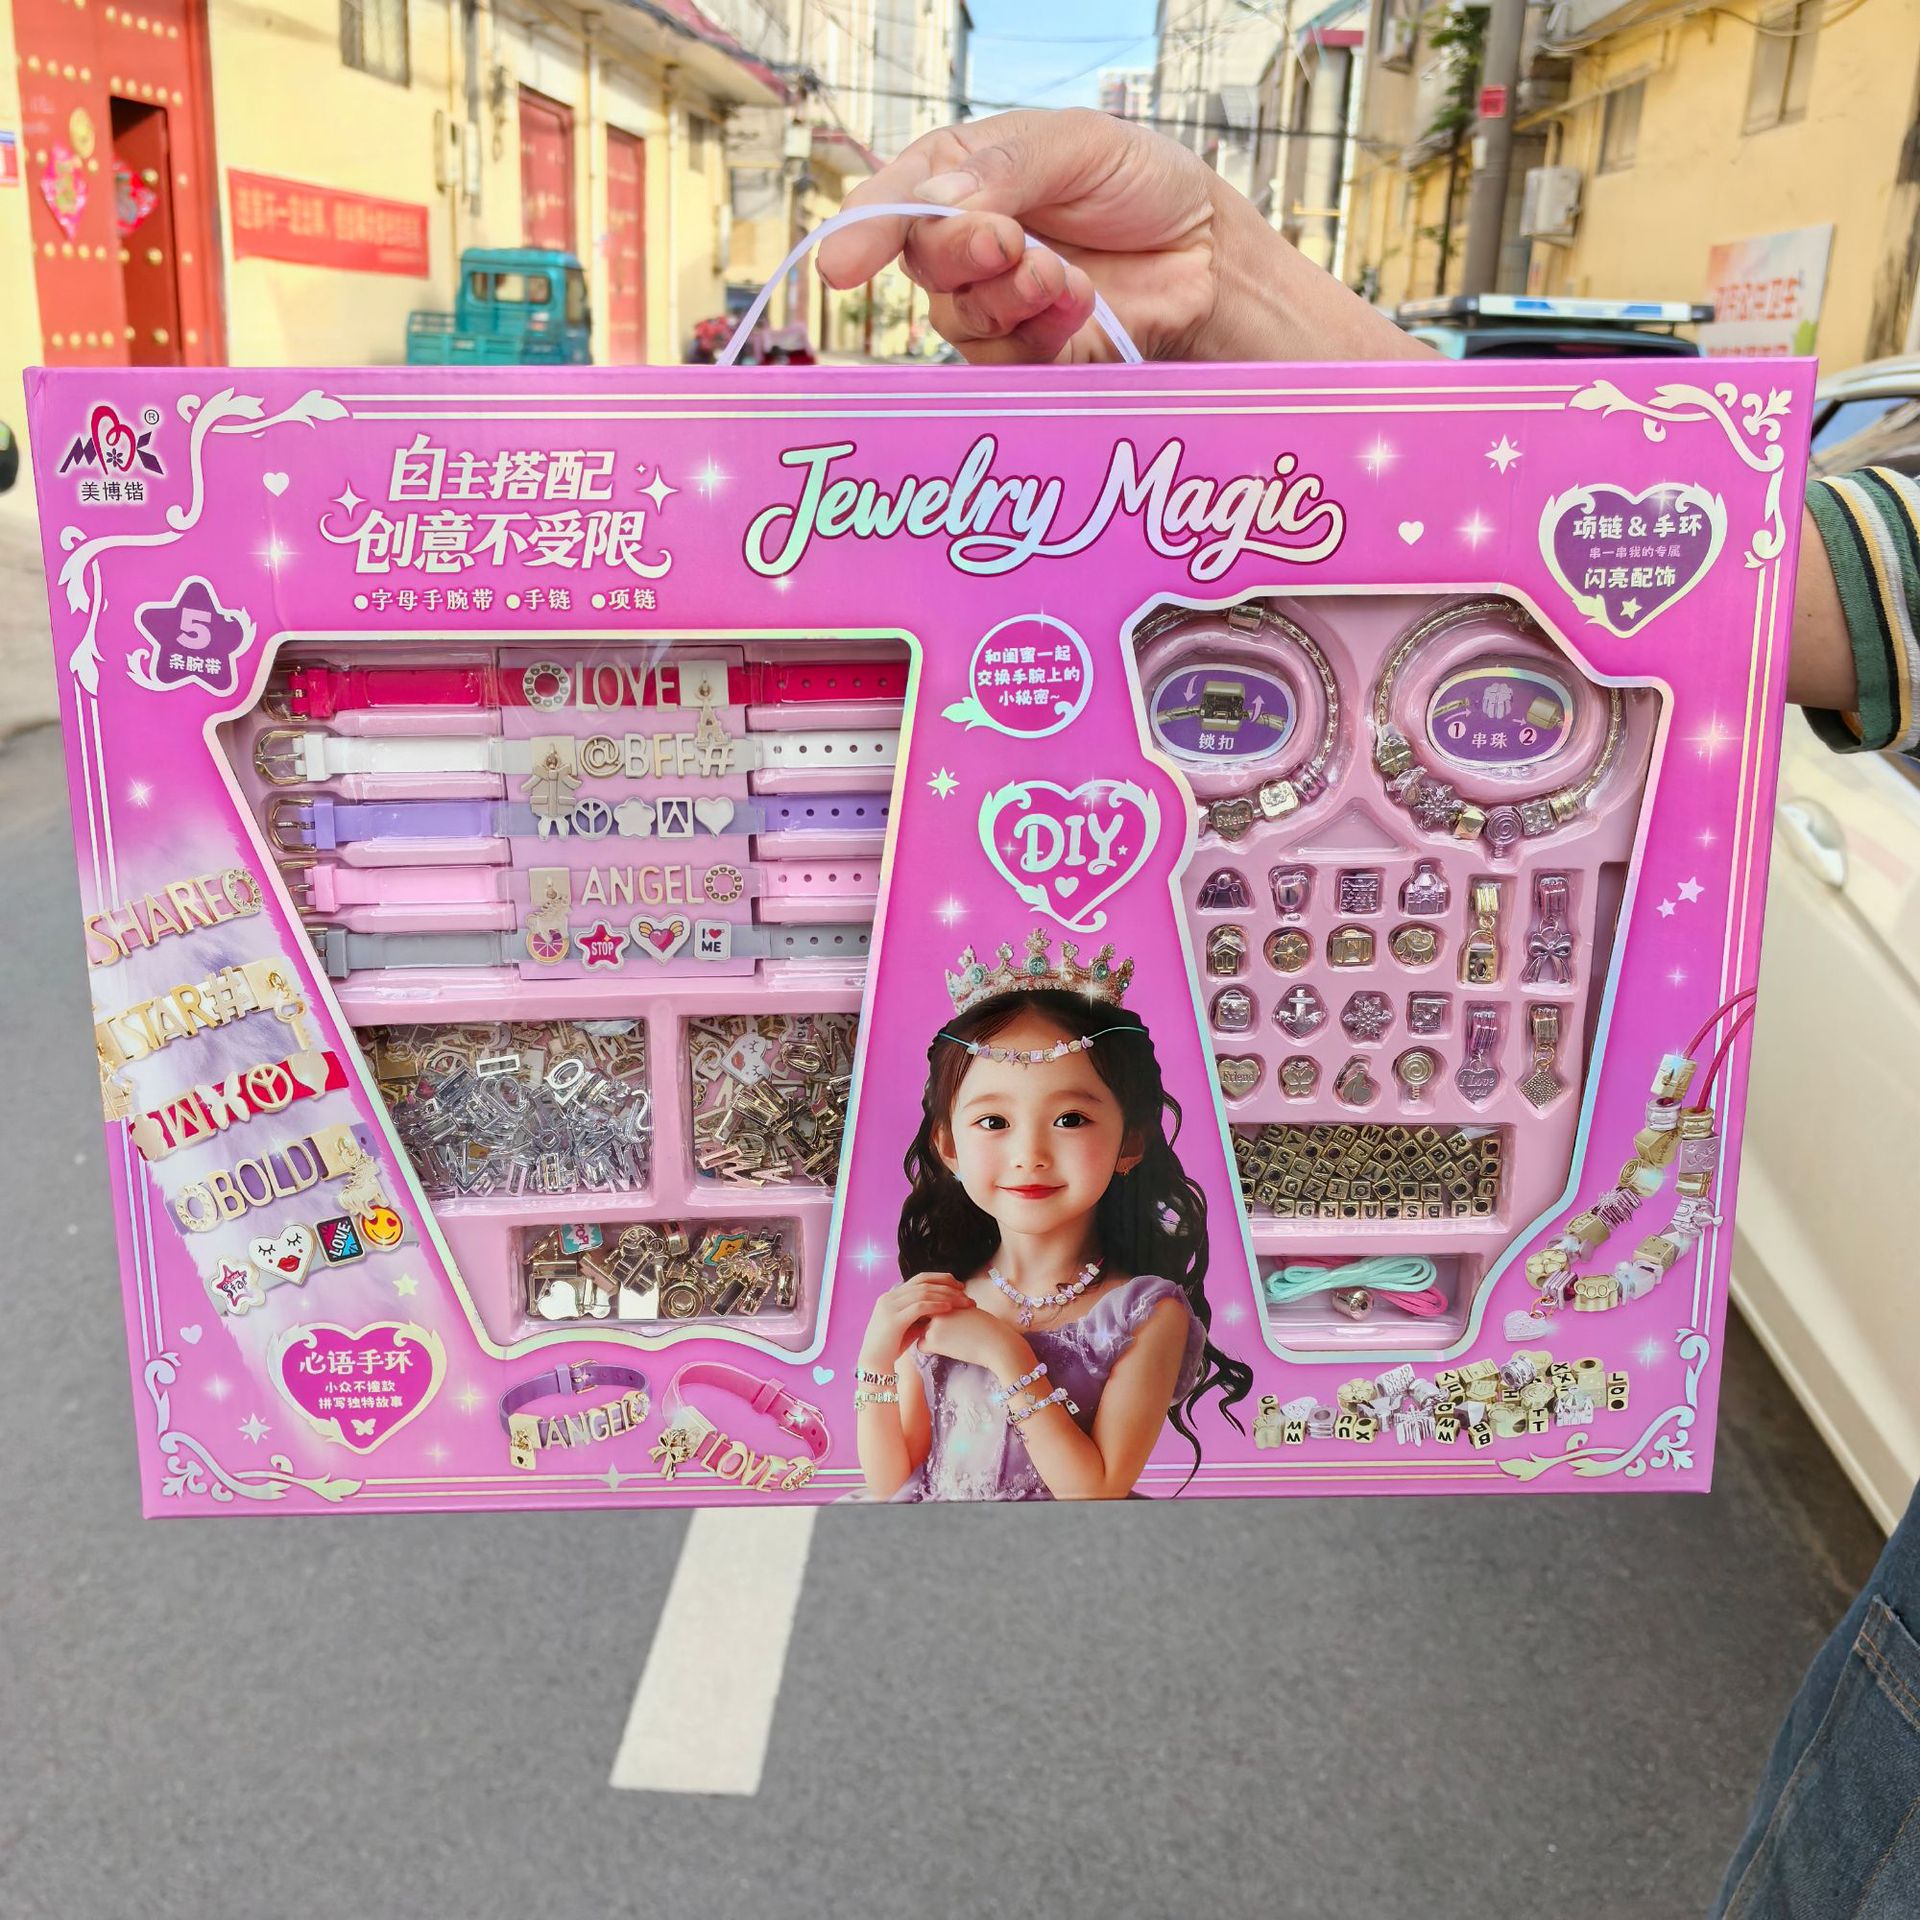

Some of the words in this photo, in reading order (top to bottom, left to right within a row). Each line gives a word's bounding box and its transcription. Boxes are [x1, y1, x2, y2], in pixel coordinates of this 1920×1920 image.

[389, 433, 615, 501] 自主搭配
[81, 482, 144, 501] 美博锴
[742, 434, 1063, 577] Jewelry
[1085, 437, 1346, 583] Magic
[1573, 514, 1623, 540] 项链
[1628, 516, 1647, 538] &
[1653, 514, 1702, 538] 手环
[320, 509, 672, 578] 创意不受限
[1589, 545, 1681, 559] 串一串我的专属
[1584, 566, 1676, 590] 闪亮配饰
[372, 589, 493, 611] 字母手腕带
[524, 588, 571, 610] 手链
[608, 588, 656, 610] 项链
[176, 607, 211, 650] 5
[169, 653, 222, 675] 条腕带
[985, 645, 1071, 664] 和闺蜜一起
[575, 661, 677, 712] LOVE
[977, 666, 1080, 686] 交换手腕上的
[1199, 733, 1234, 750] 锁扣
[1472, 732, 1508, 748] 串珠
[1014, 813, 1124, 875] DIY
[581, 865, 705, 905] ANGEL
[84, 875, 239, 968] SHARE
[591, 940, 614, 956] STOP
[701, 940, 721, 952] ME
[208, 1140, 318, 1221] BOLD
[329, 1222, 350, 1257] LOVE
[300, 1349, 413, 1374] 心语手环
[325, 1380, 395, 1393] 小众不撞款
[319, 1396, 403, 1410] 拼写独特故事
[543, 1400, 635, 1449] ANGEL
[701, 1433, 788, 1492] LOVE
